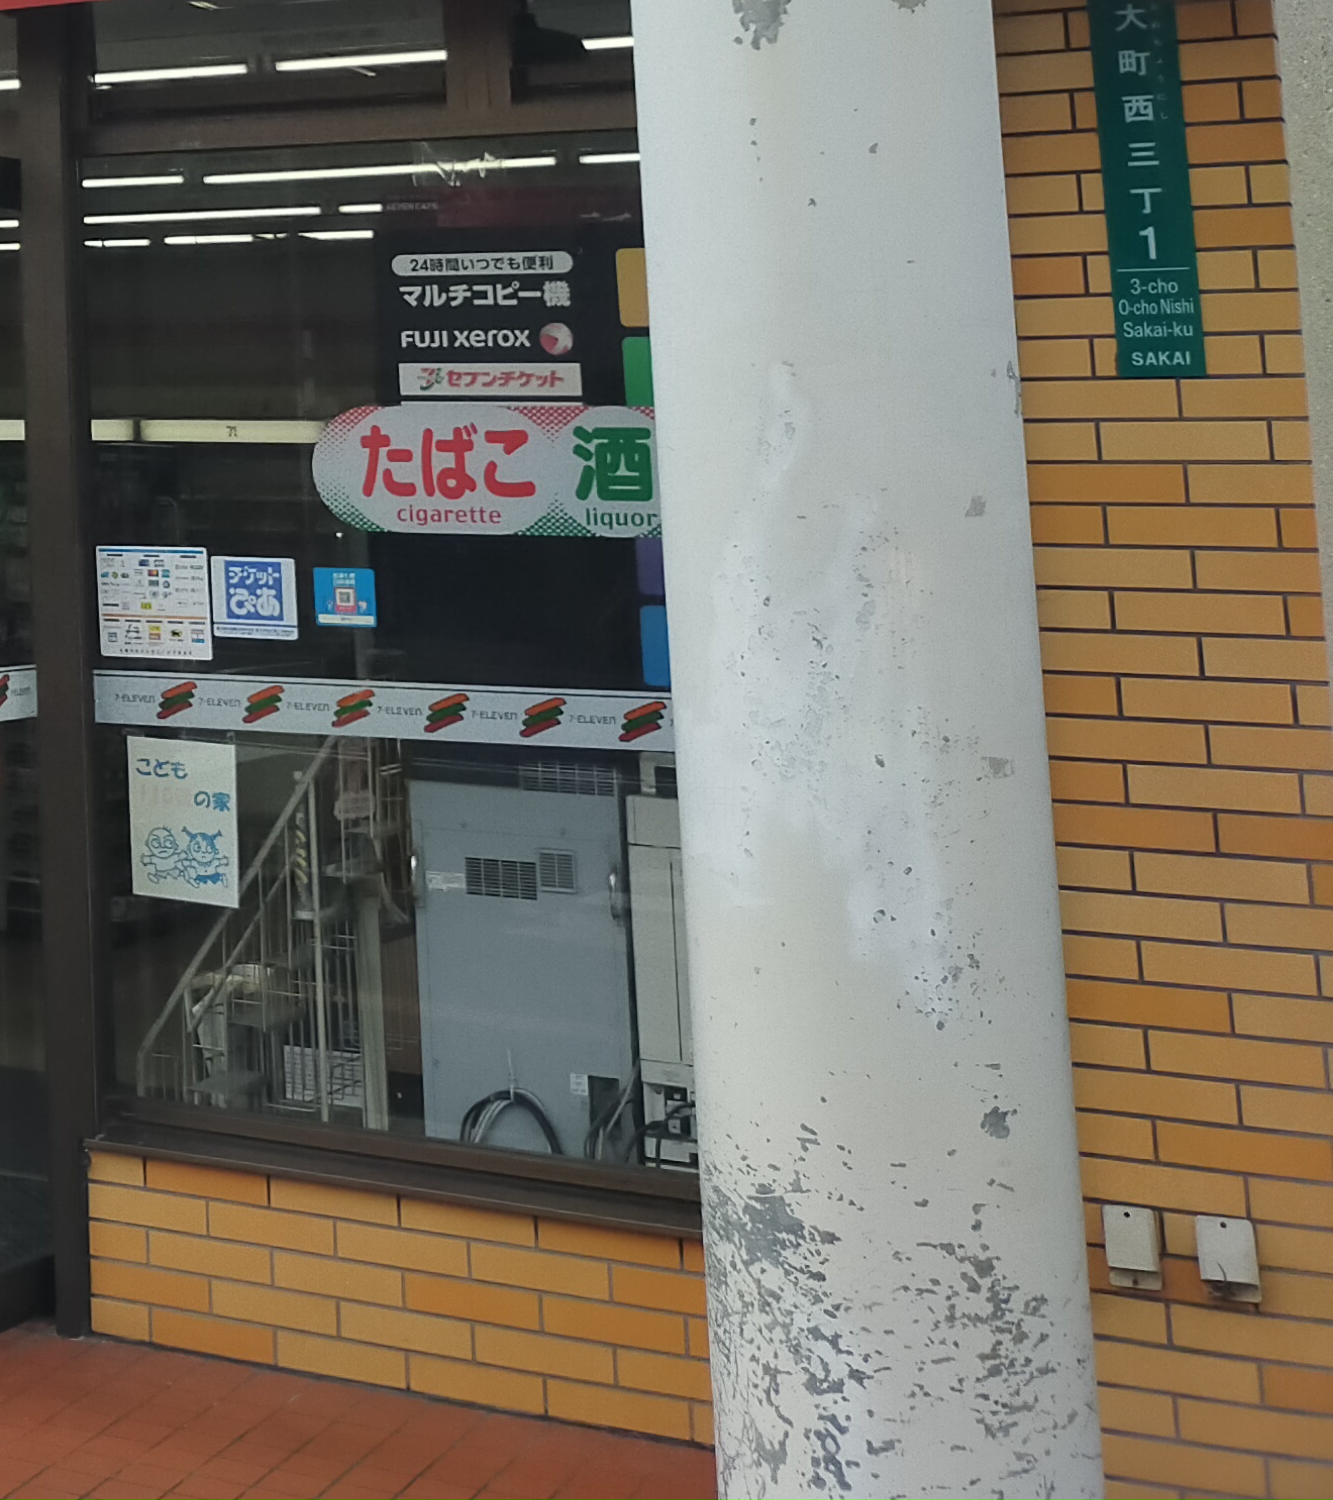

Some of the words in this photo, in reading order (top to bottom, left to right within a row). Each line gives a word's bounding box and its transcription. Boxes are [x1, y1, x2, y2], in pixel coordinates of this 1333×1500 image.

[408, 255, 554, 273] 24時間いつでも便利
[398, 280, 571, 308] マルチコピー機
[1130, 277, 1179, 295] 3-cho
[1160, 297, 1195, 314] Nishi
[1123, 320, 1194, 338] Sakai-ku
[400, 330, 449, 349] FUJI
[1131, 351, 1192, 366] SAKAI
[446, 368, 565, 388] セブンチケット
[360, 422, 536, 499] たばこ
[572, 425, 654, 502] 酒
[396, 505, 502, 526] cigarette
[585, 507, 658, 529] liquor
[228, 566, 280, 585] チケット
[229, 587, 281, 617] ぴあ
[135, 758, 188, 780] こども
[193, 790, 231, 813] の家
